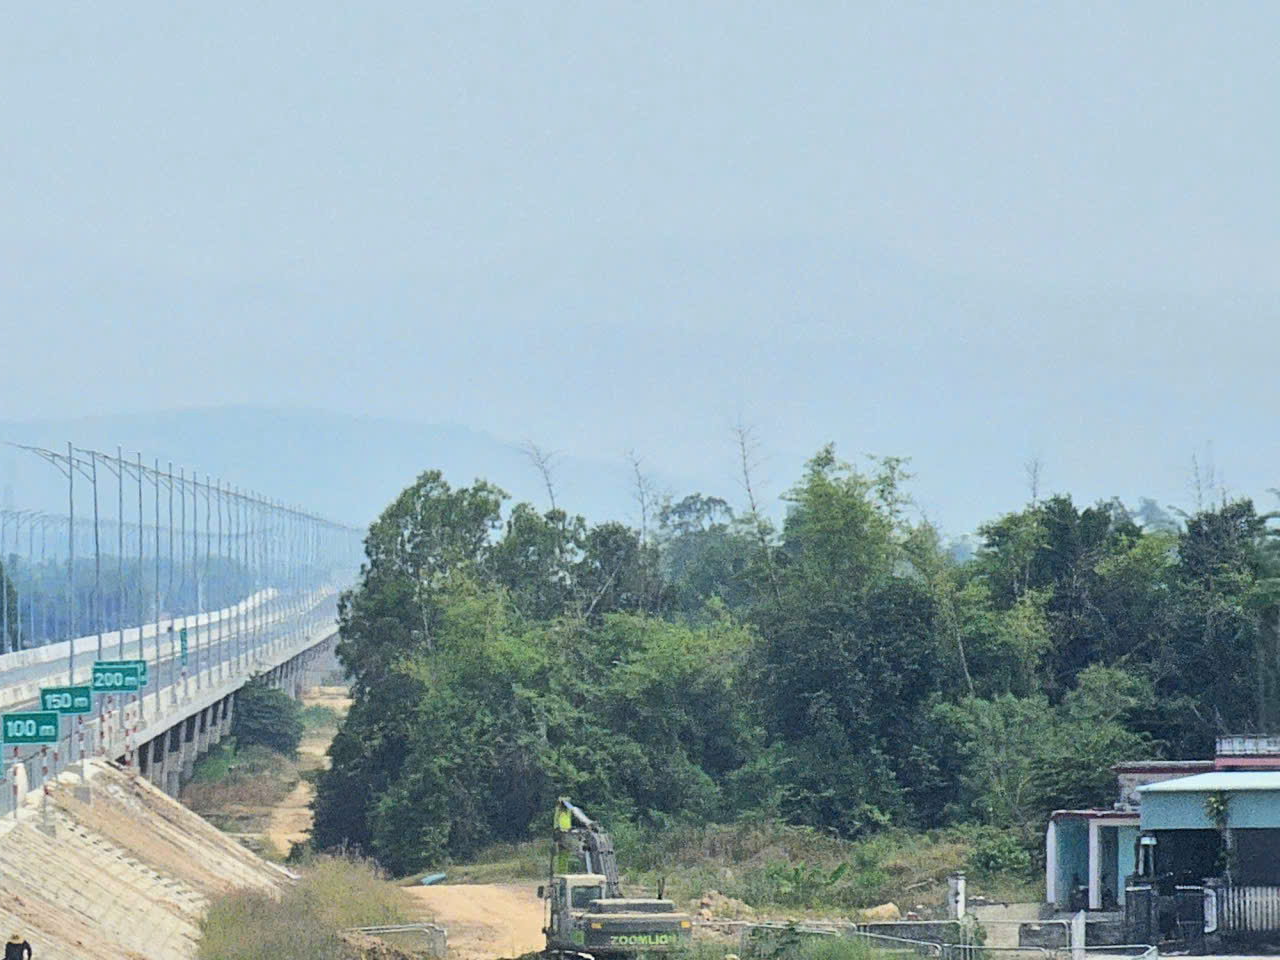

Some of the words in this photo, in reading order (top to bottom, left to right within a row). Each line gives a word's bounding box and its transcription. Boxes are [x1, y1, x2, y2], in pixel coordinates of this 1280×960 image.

[94, 672, 123, 687] 200
[124, 676, 137, 686] m
[45, 693, 72, 709] 150
[73, 697, 88, 708] m
[7, 720, 36, 737] 100
[39, 725, 55, 736] m
